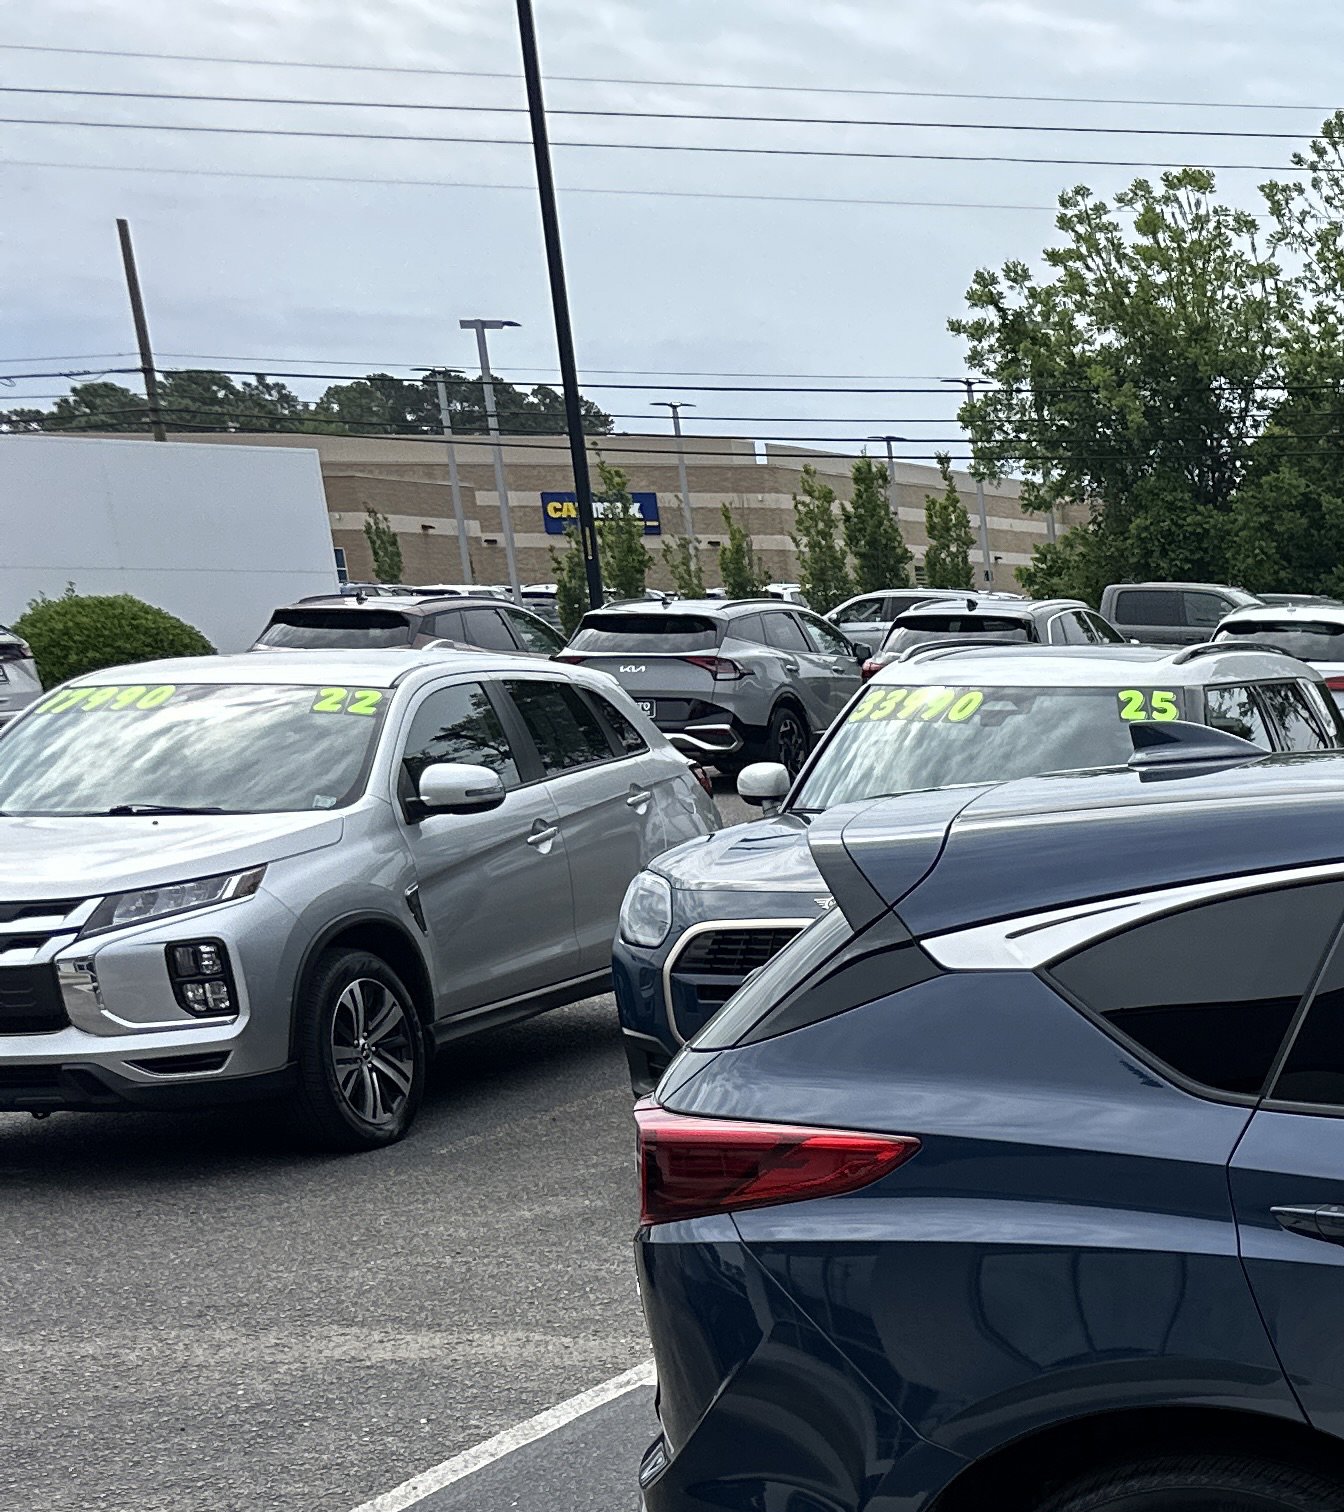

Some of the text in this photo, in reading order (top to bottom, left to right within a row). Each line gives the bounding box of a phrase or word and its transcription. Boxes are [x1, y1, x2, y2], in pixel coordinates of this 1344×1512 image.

[35, 685, 383, 714] 17990 22
[1118, 690, 1178, 721] 25
